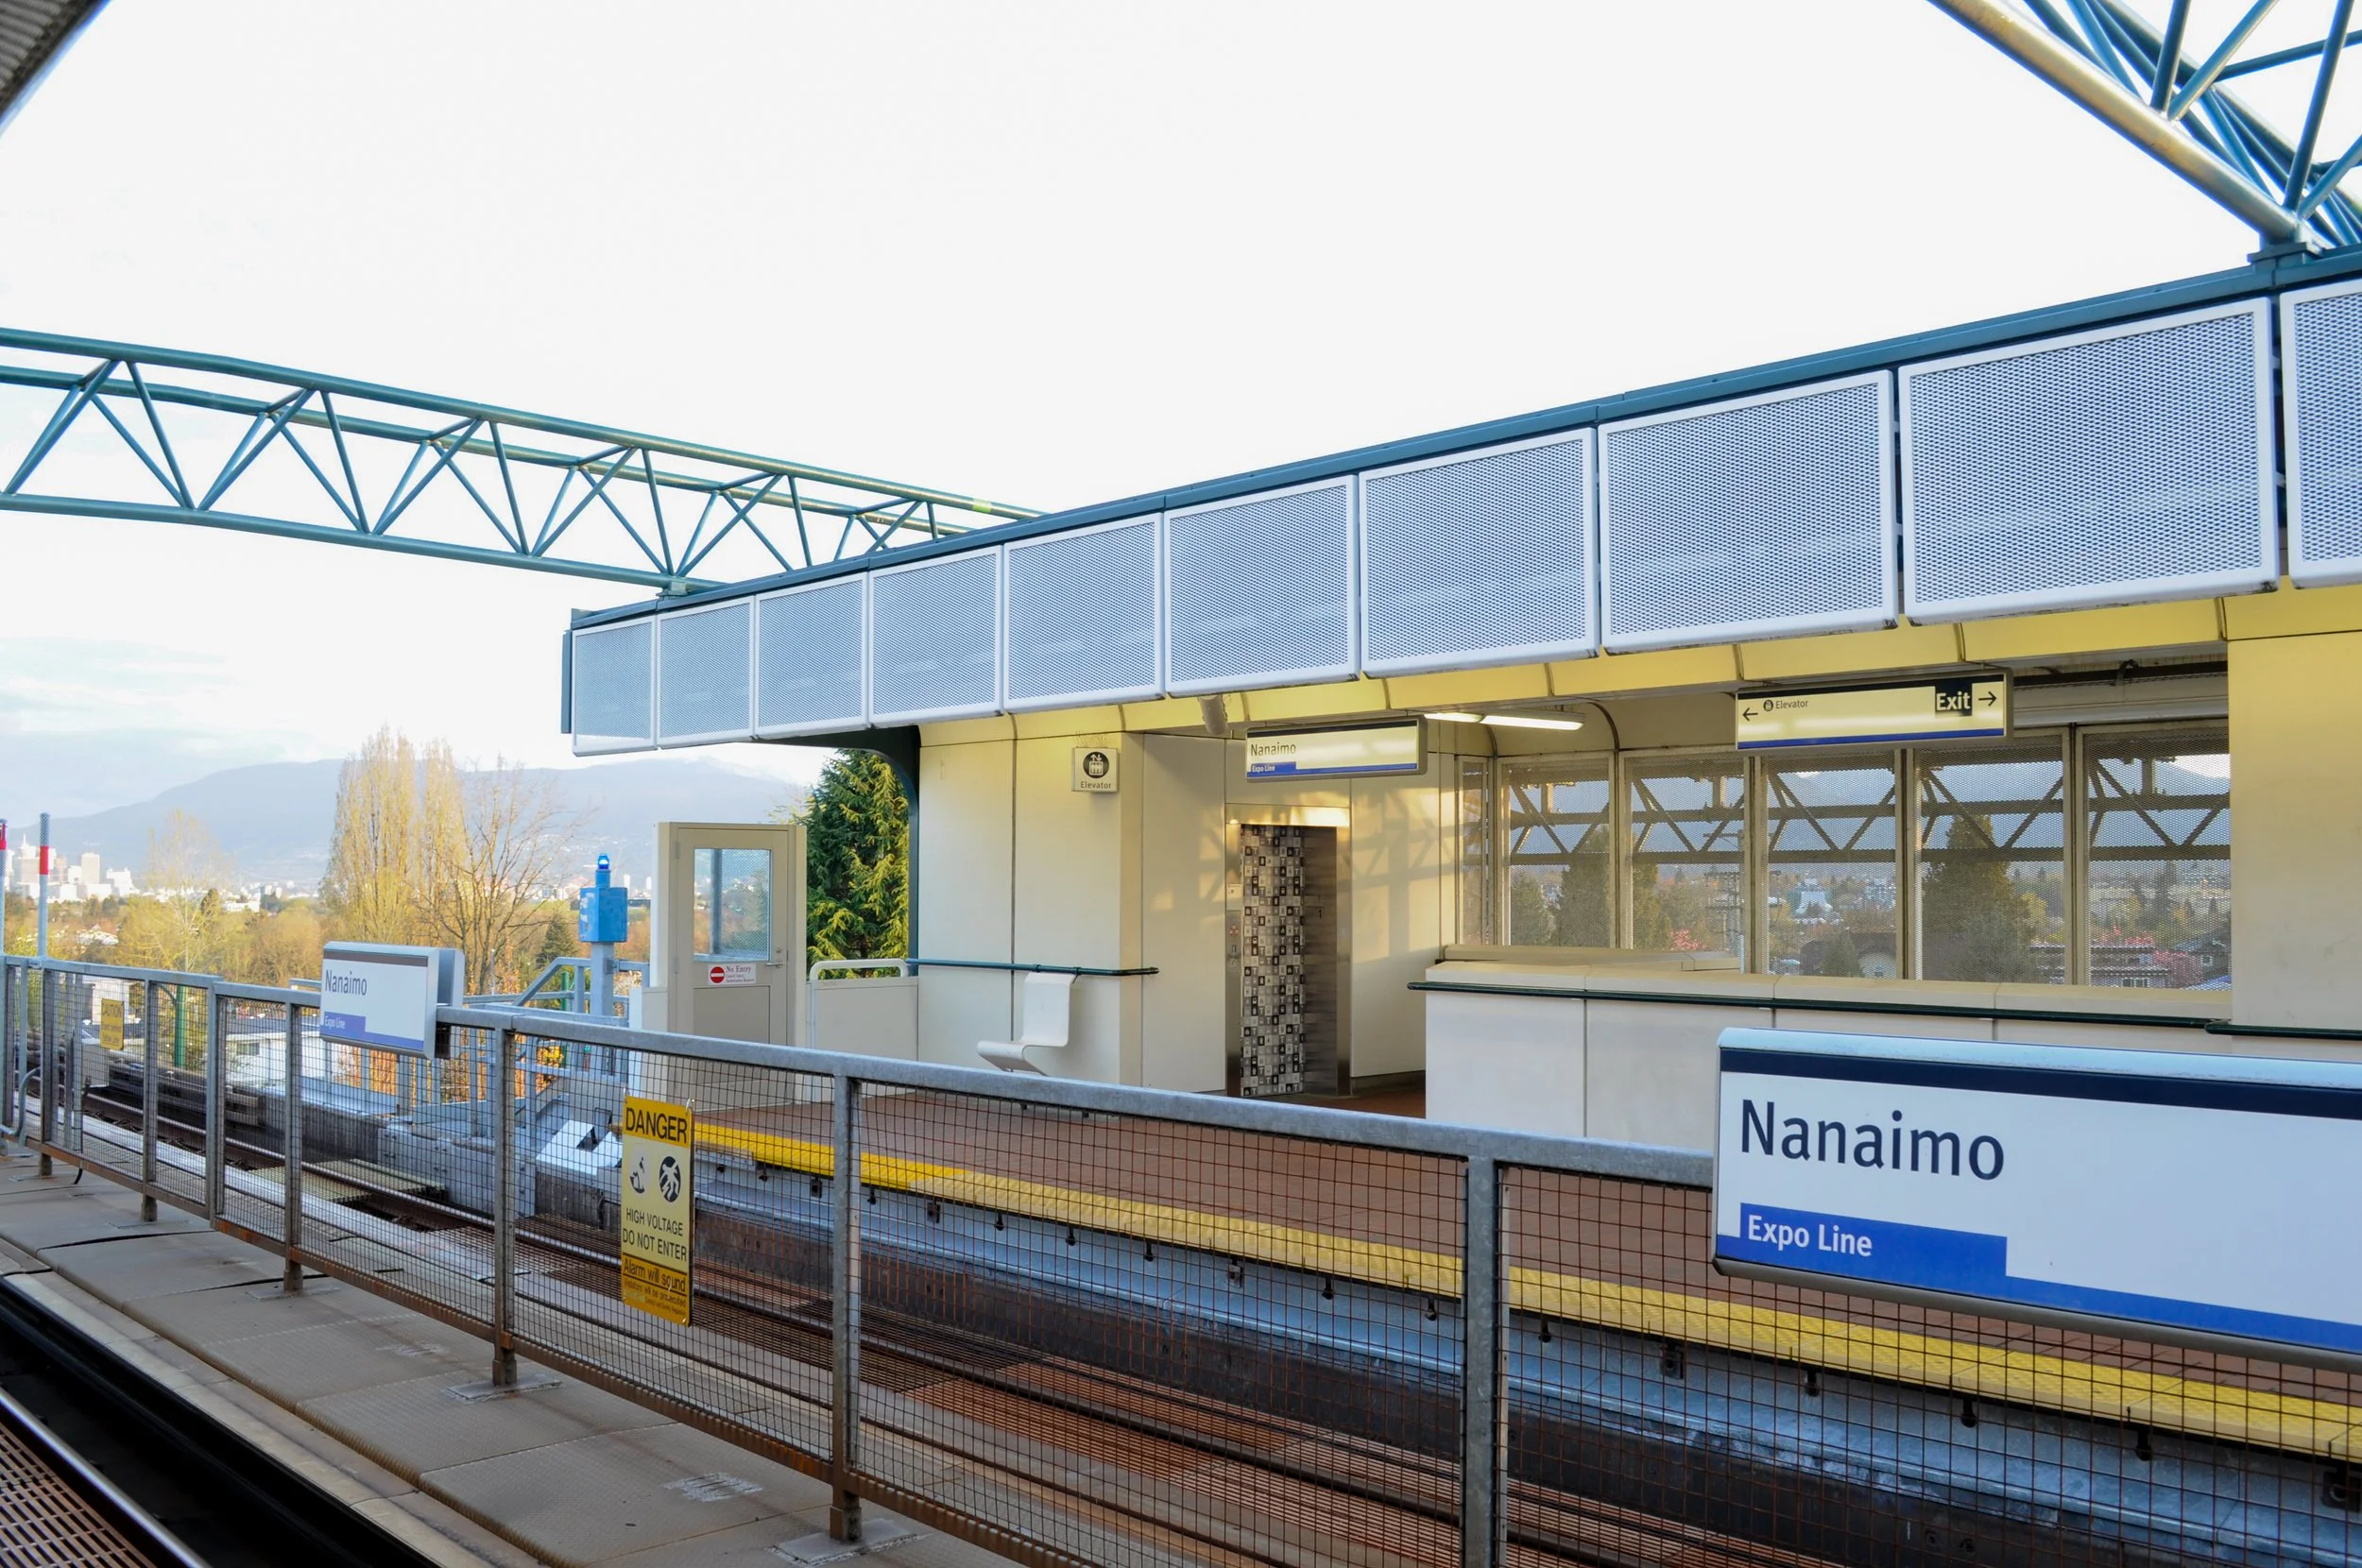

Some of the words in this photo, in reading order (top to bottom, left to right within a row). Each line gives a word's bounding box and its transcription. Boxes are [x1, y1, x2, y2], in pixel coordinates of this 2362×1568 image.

[1775, 700, 1808, 709] Elevator
[1936, 690, 1971, 710] Exit
[1250, 741, 1296, 757] Nanaimo
[325, 969, 368, 997] Nanaimo
[324, 1014, 336, 1030] Expo
[335, 1016, 346, 1030] Line
[625, 1106, 688, 1144] DANGER
[1741, 1099, 2005, 1181] Nanaimo
[625, 1207, 645, 1226] HIGH
[646, 1212, 683, 1237] VOLTAGE
[1748, 1214, 1810, 1252] Expo
[1819, 1223, 1873, 1257] Line
[623, 1227, 635, 1246] DO
[637, 1231, 656, 1252] NOT
[658, 1238, 687, 1263] ENTER
[624, 1257, 646, 1279] Alarm
[647, 1267, 660, 1284] will
[661, 1273, 686, 1293] sound
